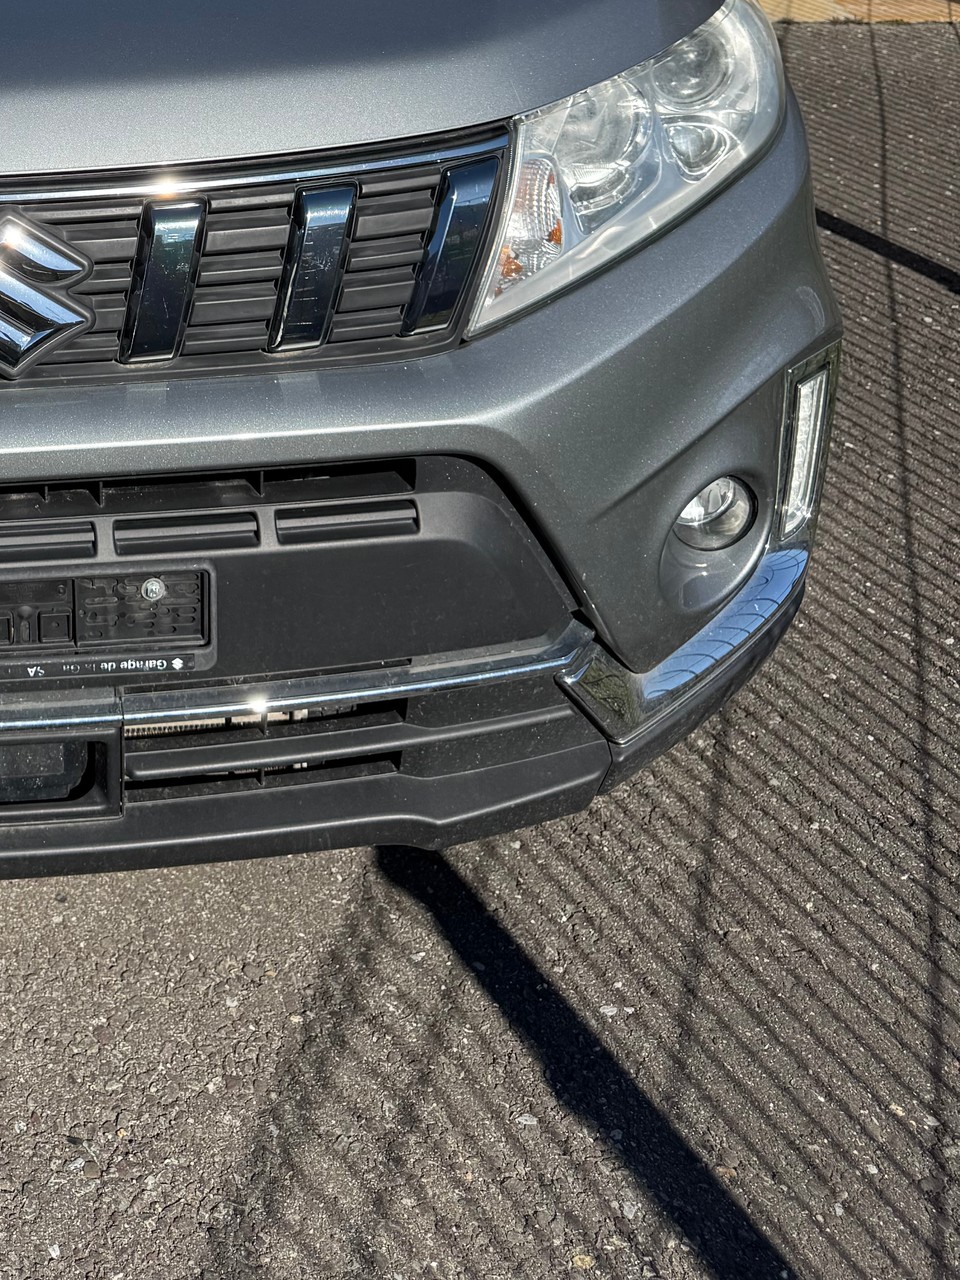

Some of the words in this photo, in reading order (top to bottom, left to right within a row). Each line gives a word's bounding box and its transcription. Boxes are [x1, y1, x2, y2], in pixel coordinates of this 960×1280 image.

[100, 662, 116, 672] de
[120, 659, 167, 671] Garage
[27, 666, 45, 677] SA
